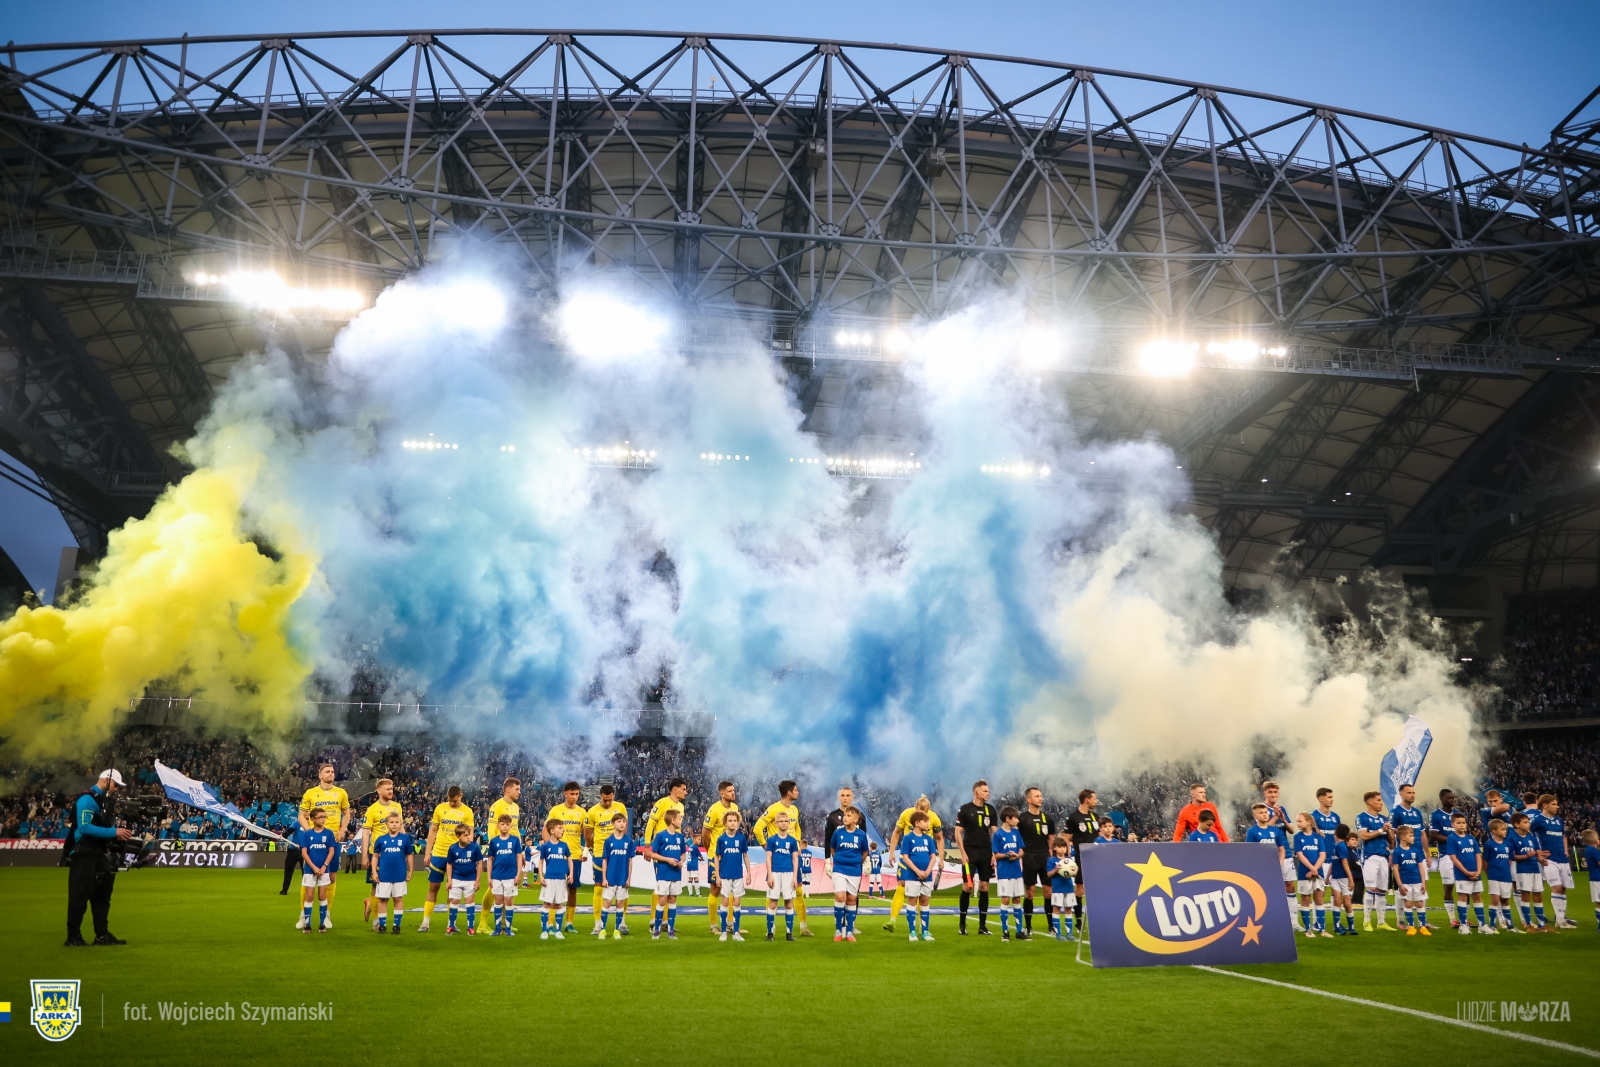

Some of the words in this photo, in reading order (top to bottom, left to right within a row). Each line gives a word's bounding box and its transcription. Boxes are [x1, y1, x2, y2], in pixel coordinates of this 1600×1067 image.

[801, 857, 811, 868] 10
[871, 858, 880, 869] 17
[1151, 886, 1241, 937] LOTTO
